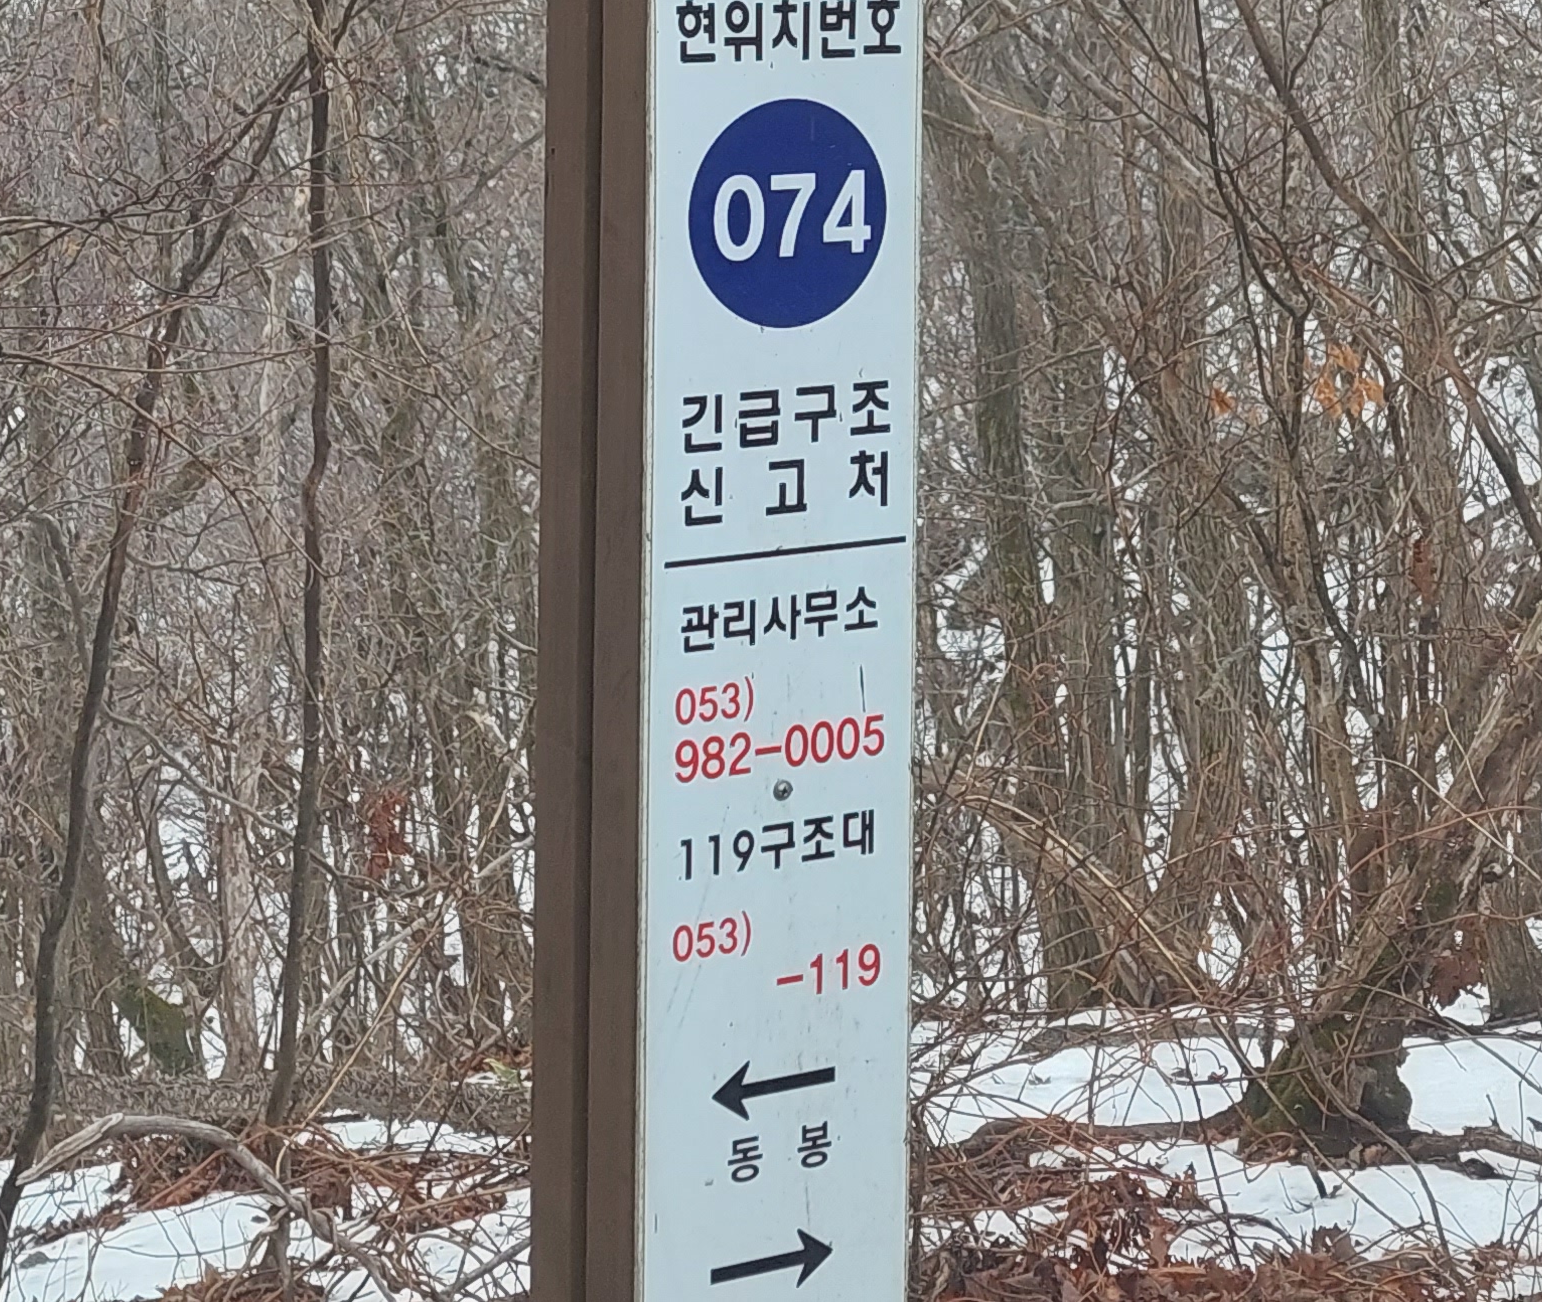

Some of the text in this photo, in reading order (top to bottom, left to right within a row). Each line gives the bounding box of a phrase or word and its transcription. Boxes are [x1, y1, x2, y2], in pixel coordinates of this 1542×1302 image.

[713, 169, 872, 262] 074
[682, 380, 891, 454] 긴급구조
[681, 586, 879, 653] 관리사무소
[675, 677, 755, 726] 053)
[674, 713, 885, 784] 982-0005
[680, 809, 875, 881] 119구조대
[672, 912, 753, 964] 053)
[776, 943, 882, 996] -119
